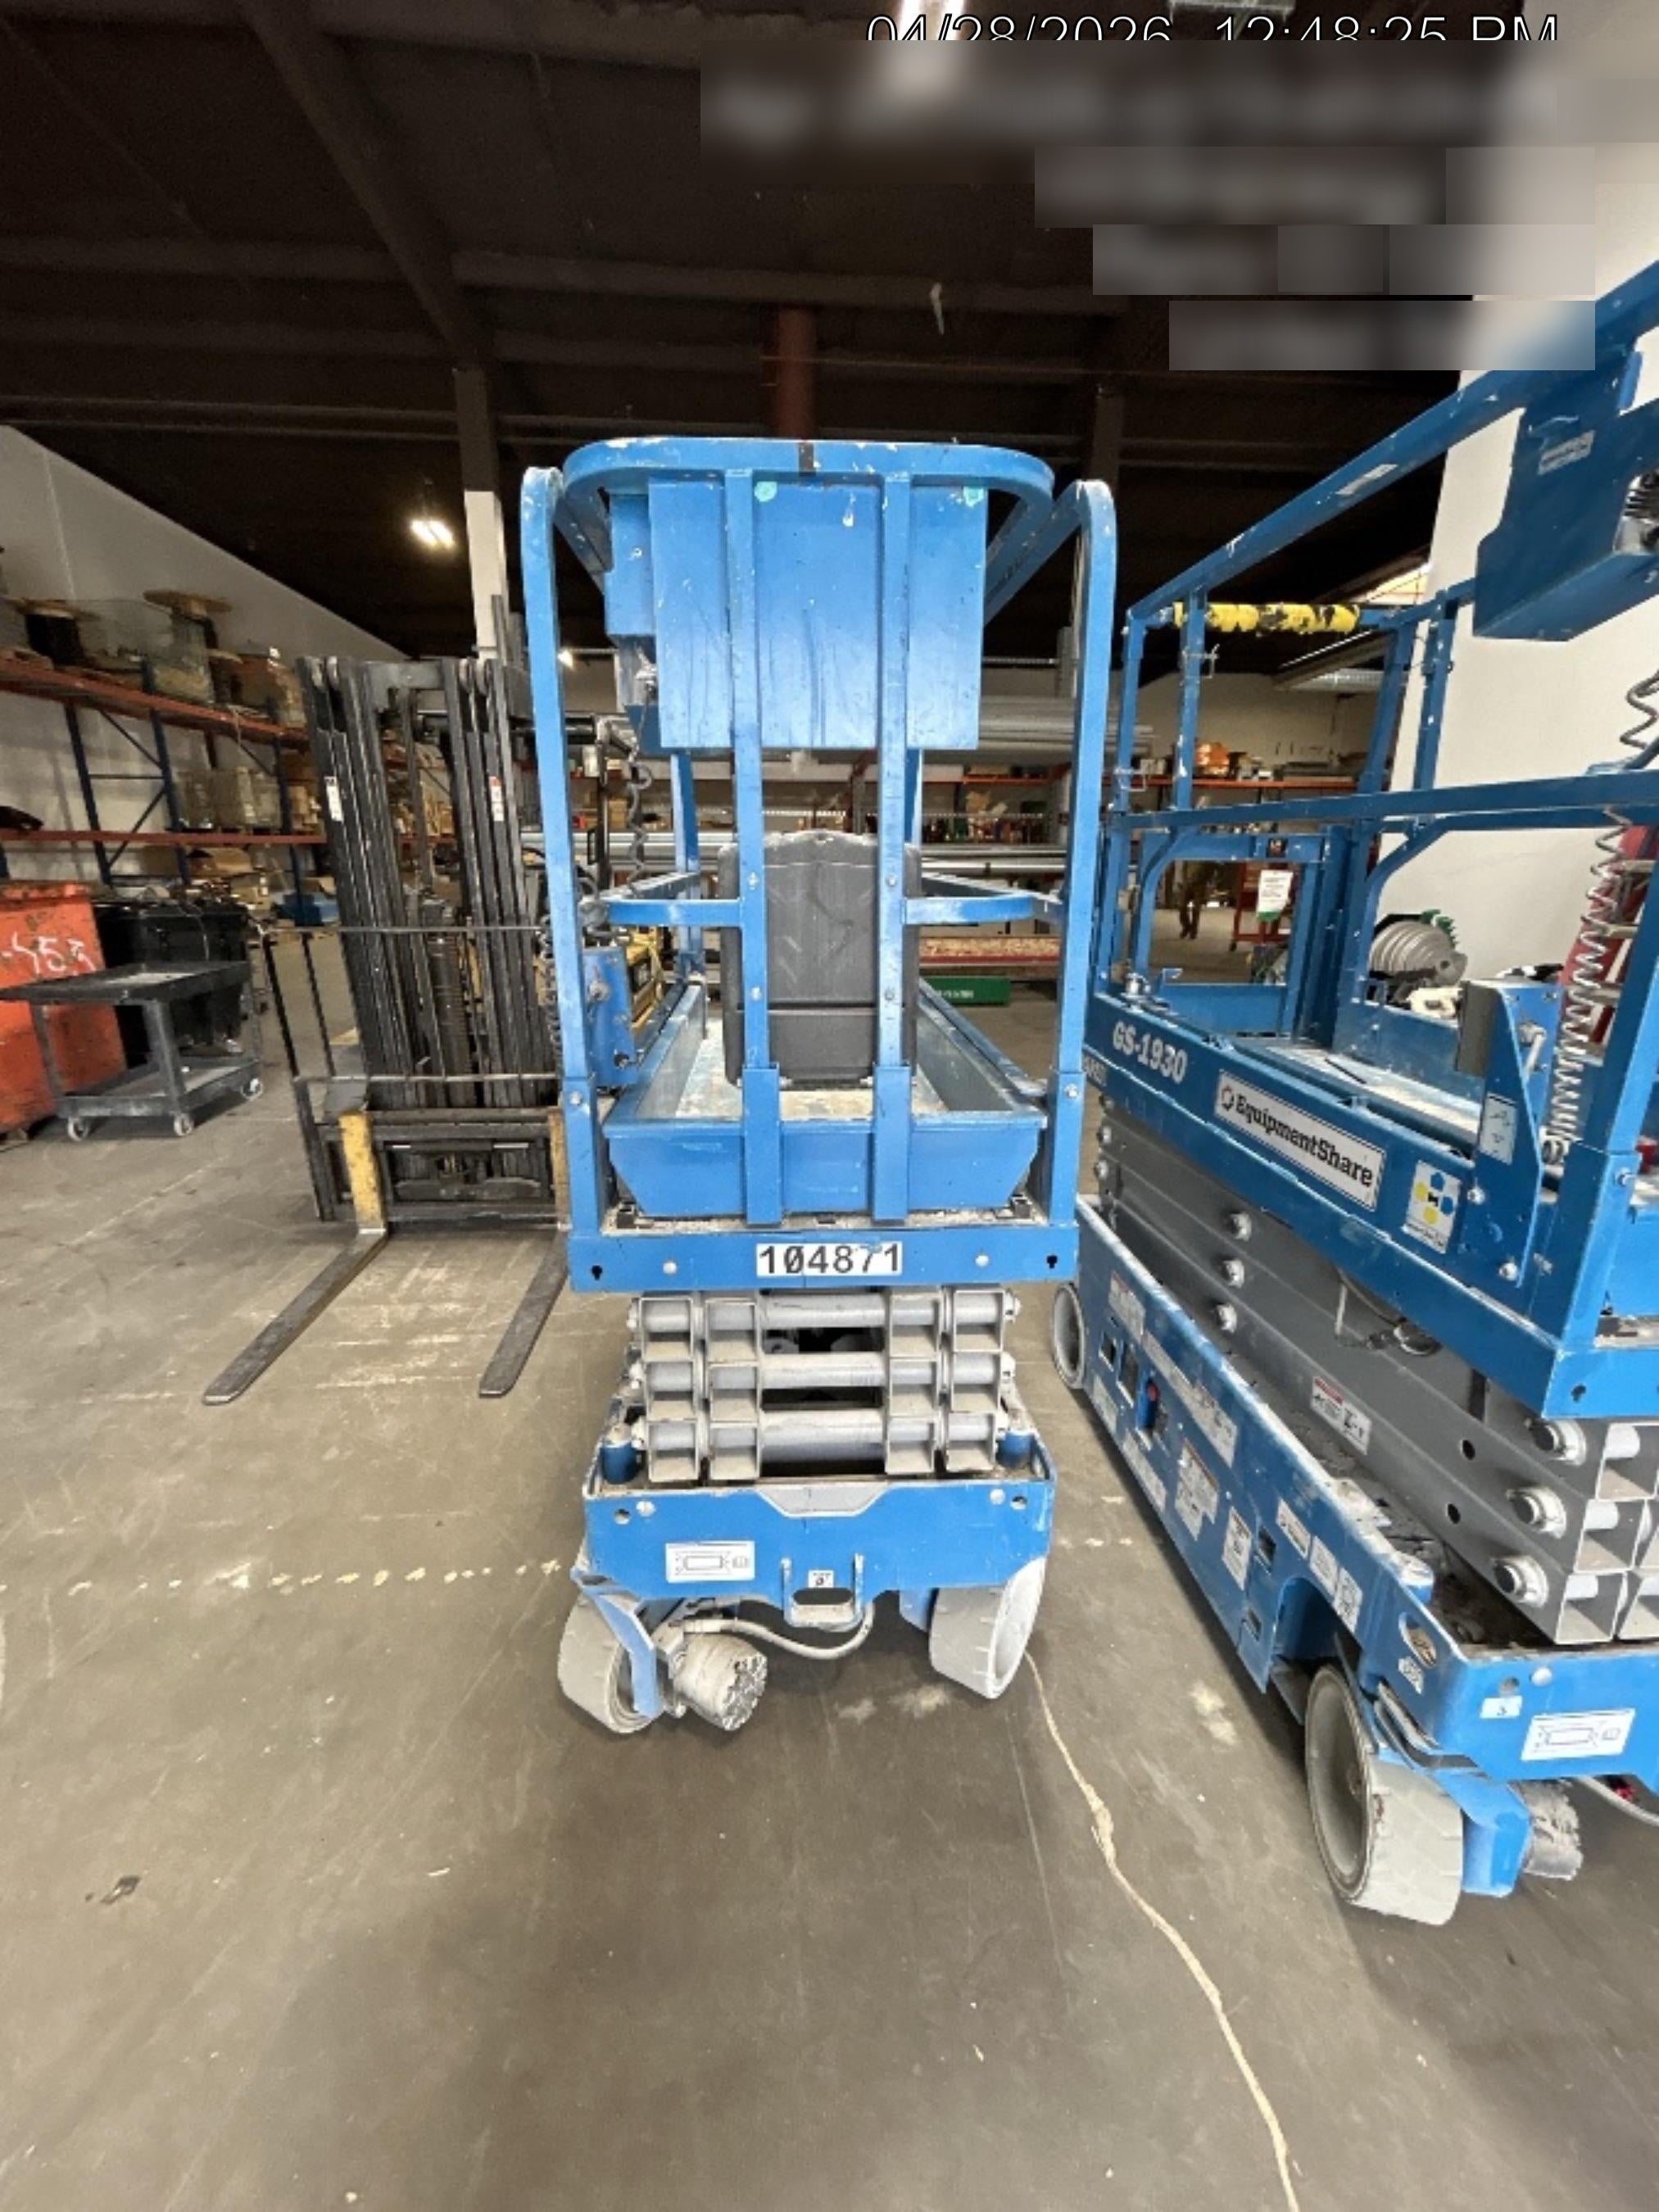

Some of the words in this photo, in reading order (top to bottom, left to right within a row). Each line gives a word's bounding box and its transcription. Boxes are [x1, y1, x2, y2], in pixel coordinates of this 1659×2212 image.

[1113, 1021, 1188, 1084] GS-1930
[1235, 1094, 1373, 1187] EquipmentShare
[759, 1243, 899, 1274] 104871
